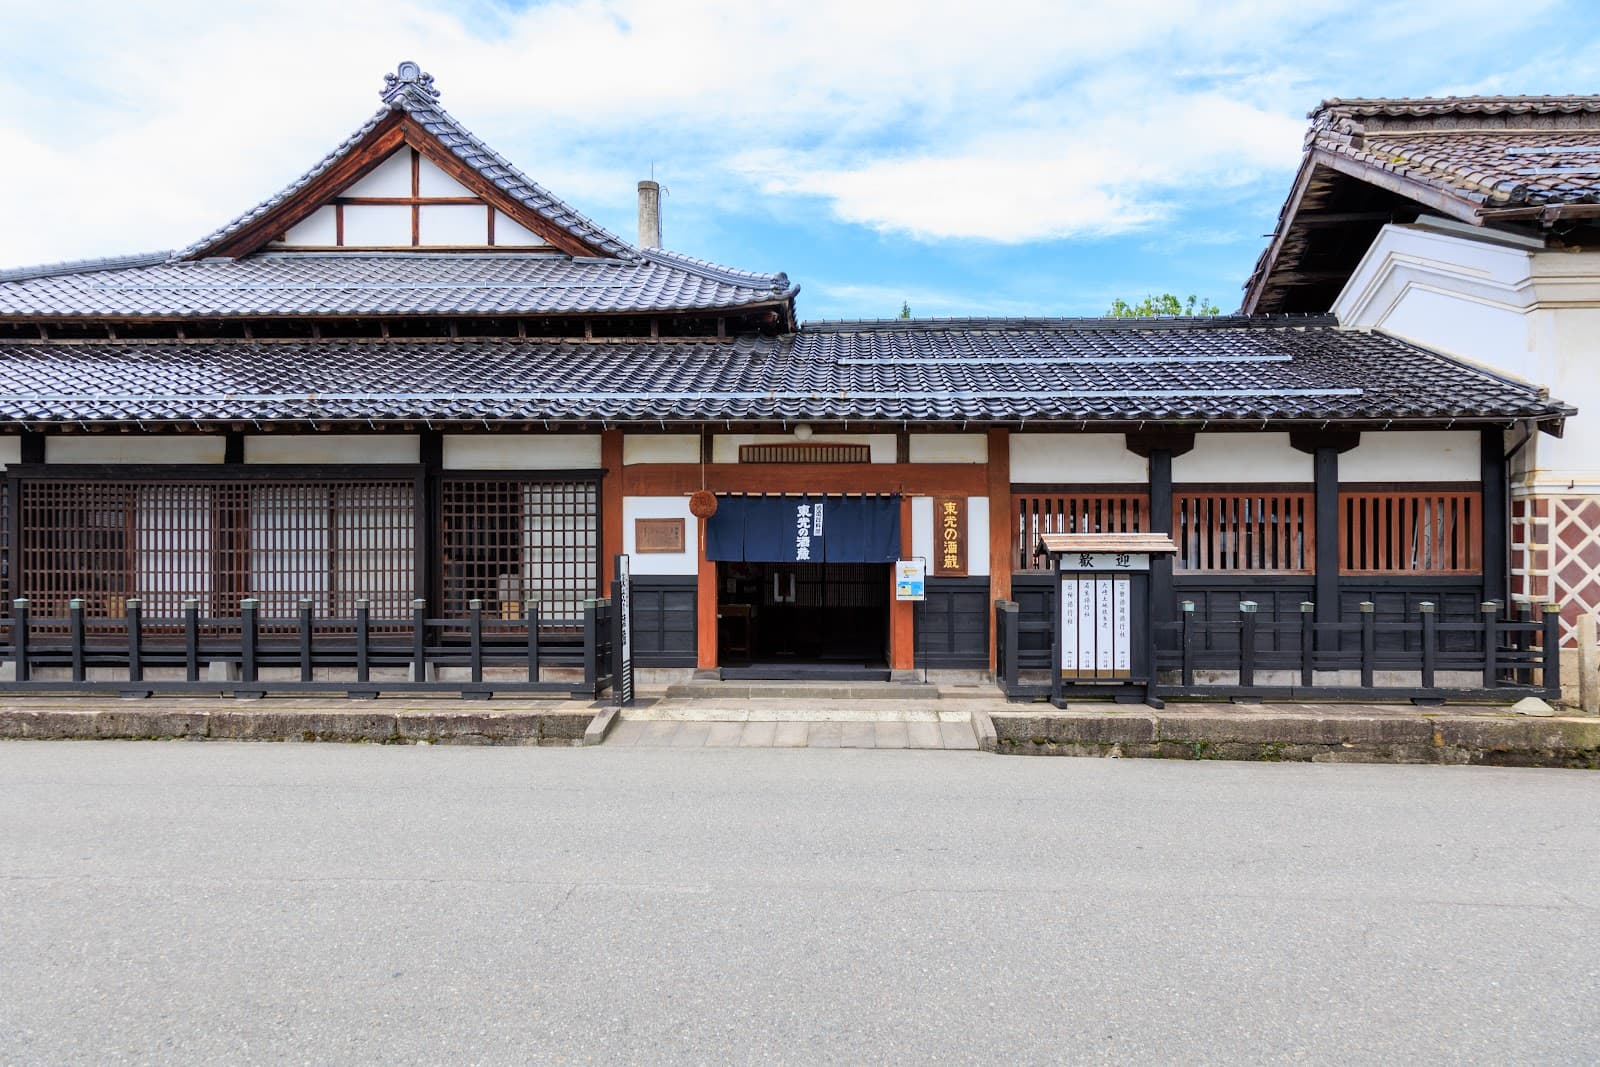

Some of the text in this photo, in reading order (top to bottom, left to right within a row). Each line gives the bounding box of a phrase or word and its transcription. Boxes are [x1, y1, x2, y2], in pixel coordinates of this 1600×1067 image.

[943, 502, 959, 568] 東光の酒蔵
